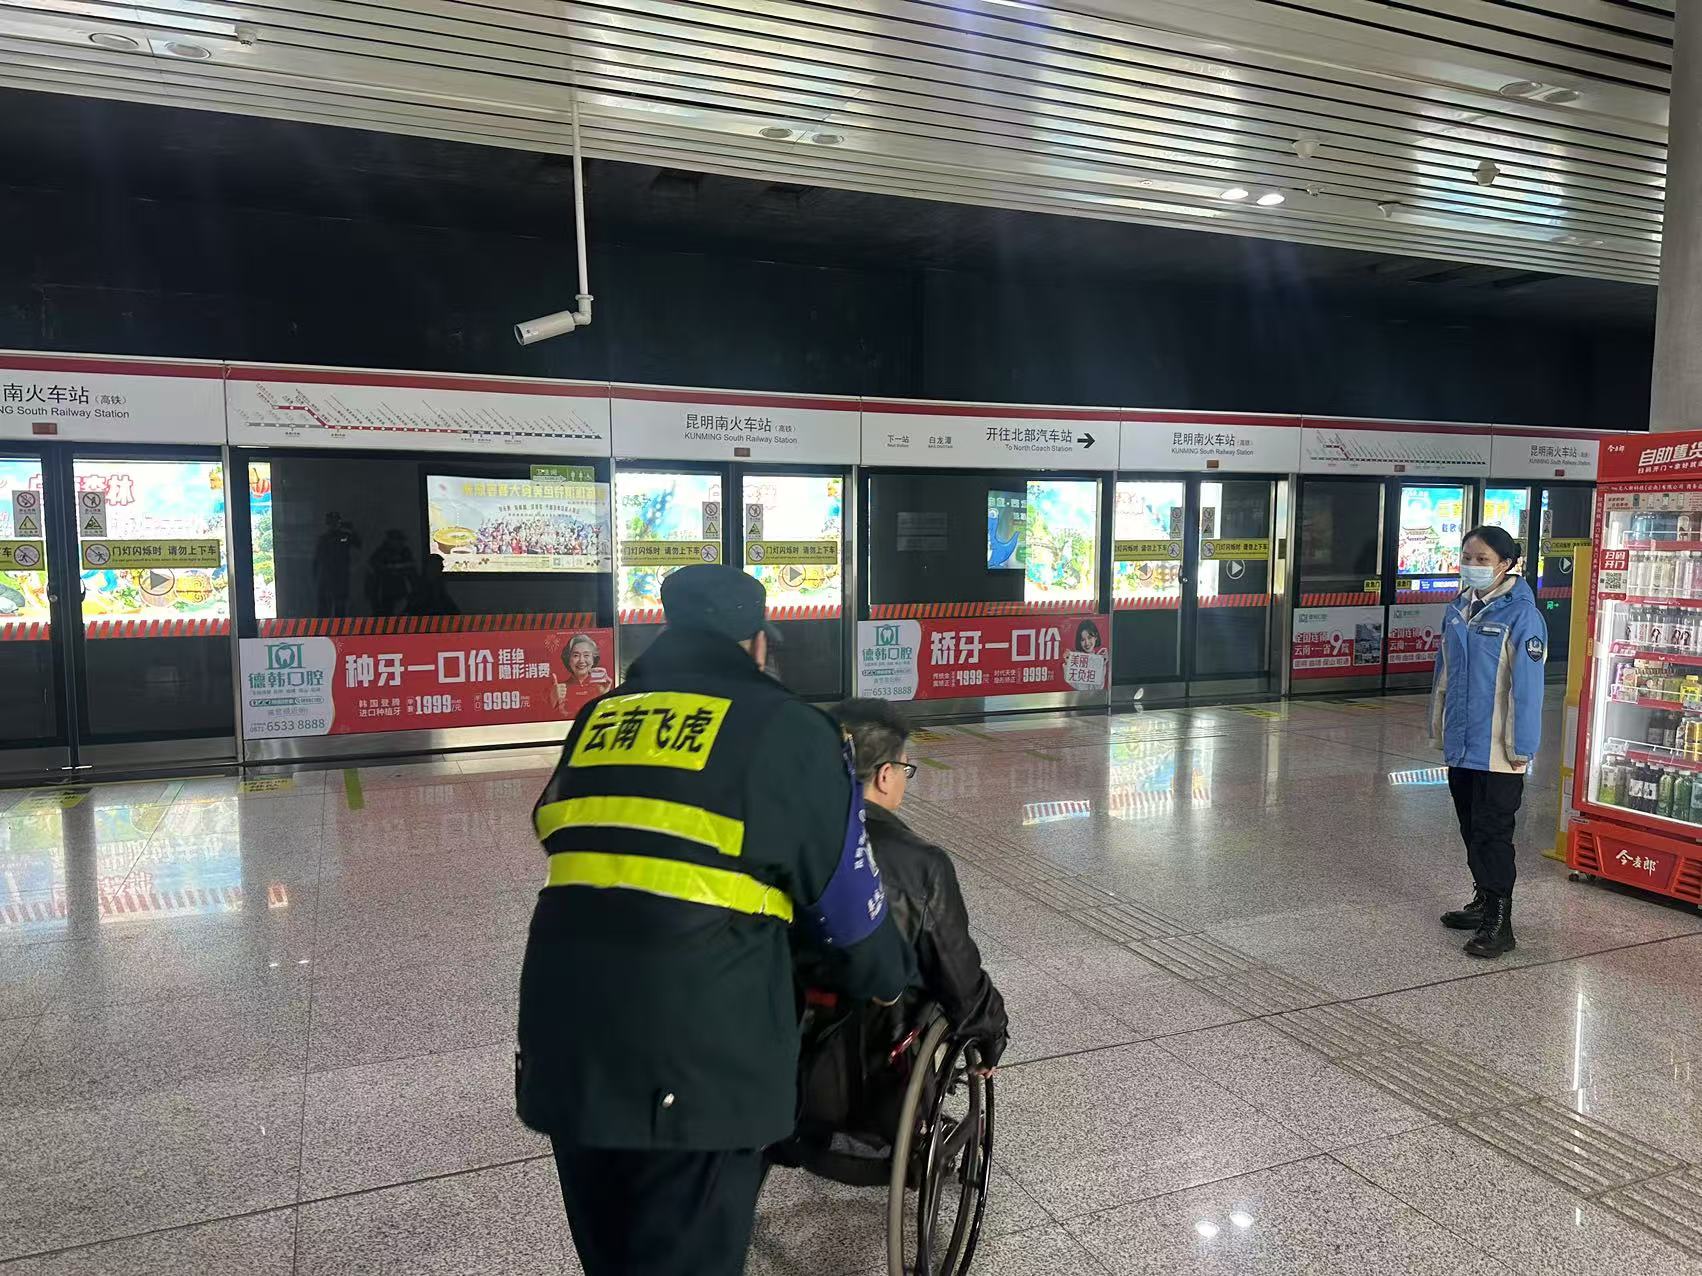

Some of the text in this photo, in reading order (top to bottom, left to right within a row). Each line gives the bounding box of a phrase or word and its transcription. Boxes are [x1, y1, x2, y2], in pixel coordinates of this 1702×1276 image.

[3, 383, 90, 405] 南火车站
[17, 406, 48, 416] South
[51, 407, 91, 419] Railway
[94, 408, 130, 419] Station
[686, 413, 772, 432] 昆明南火车站
[684, 431, 798, 445] KUNMING South Railway Station
[887, 433, 911, 444] 下一站
[986, 426, 1073, 443] 开往北部汽车站
[1173, 432, 1236, 447] 昆明南火车站
[1013, 444, 1031, 452] North
[1051, 445, 1073, 453] Station
[1171, 447, 1199, 455] KUNMING
[112, 545, 217, 556] 门灯闪烁时 请勿上下车
[1605, 551, 1626, 560] 扫码
[1605, 560, 1626, 569] 开门
[931, 627, 1062, 665] 矫牙一口价
[498, 648, 525, 664] 拒绝
[1071, 654, 1089, 669] 美丽
[345, 649, 495, 688] 种牙一口价
[498, 663, 550, 680] 隐形消费
[1022, 666, 1048, 682] 9999
[1069, 669, 1096, 683] 无负担
[248, 670, 324, 688] 德韩口腔
[872, 687, 892, 696] 6533
[483, 691, 520, 711] 9999
[297, 718, 325, 730] 8888
[582, 704, 716, 753] 云南飞虎
[1615, 849, 1657, 877] 今麦郎
